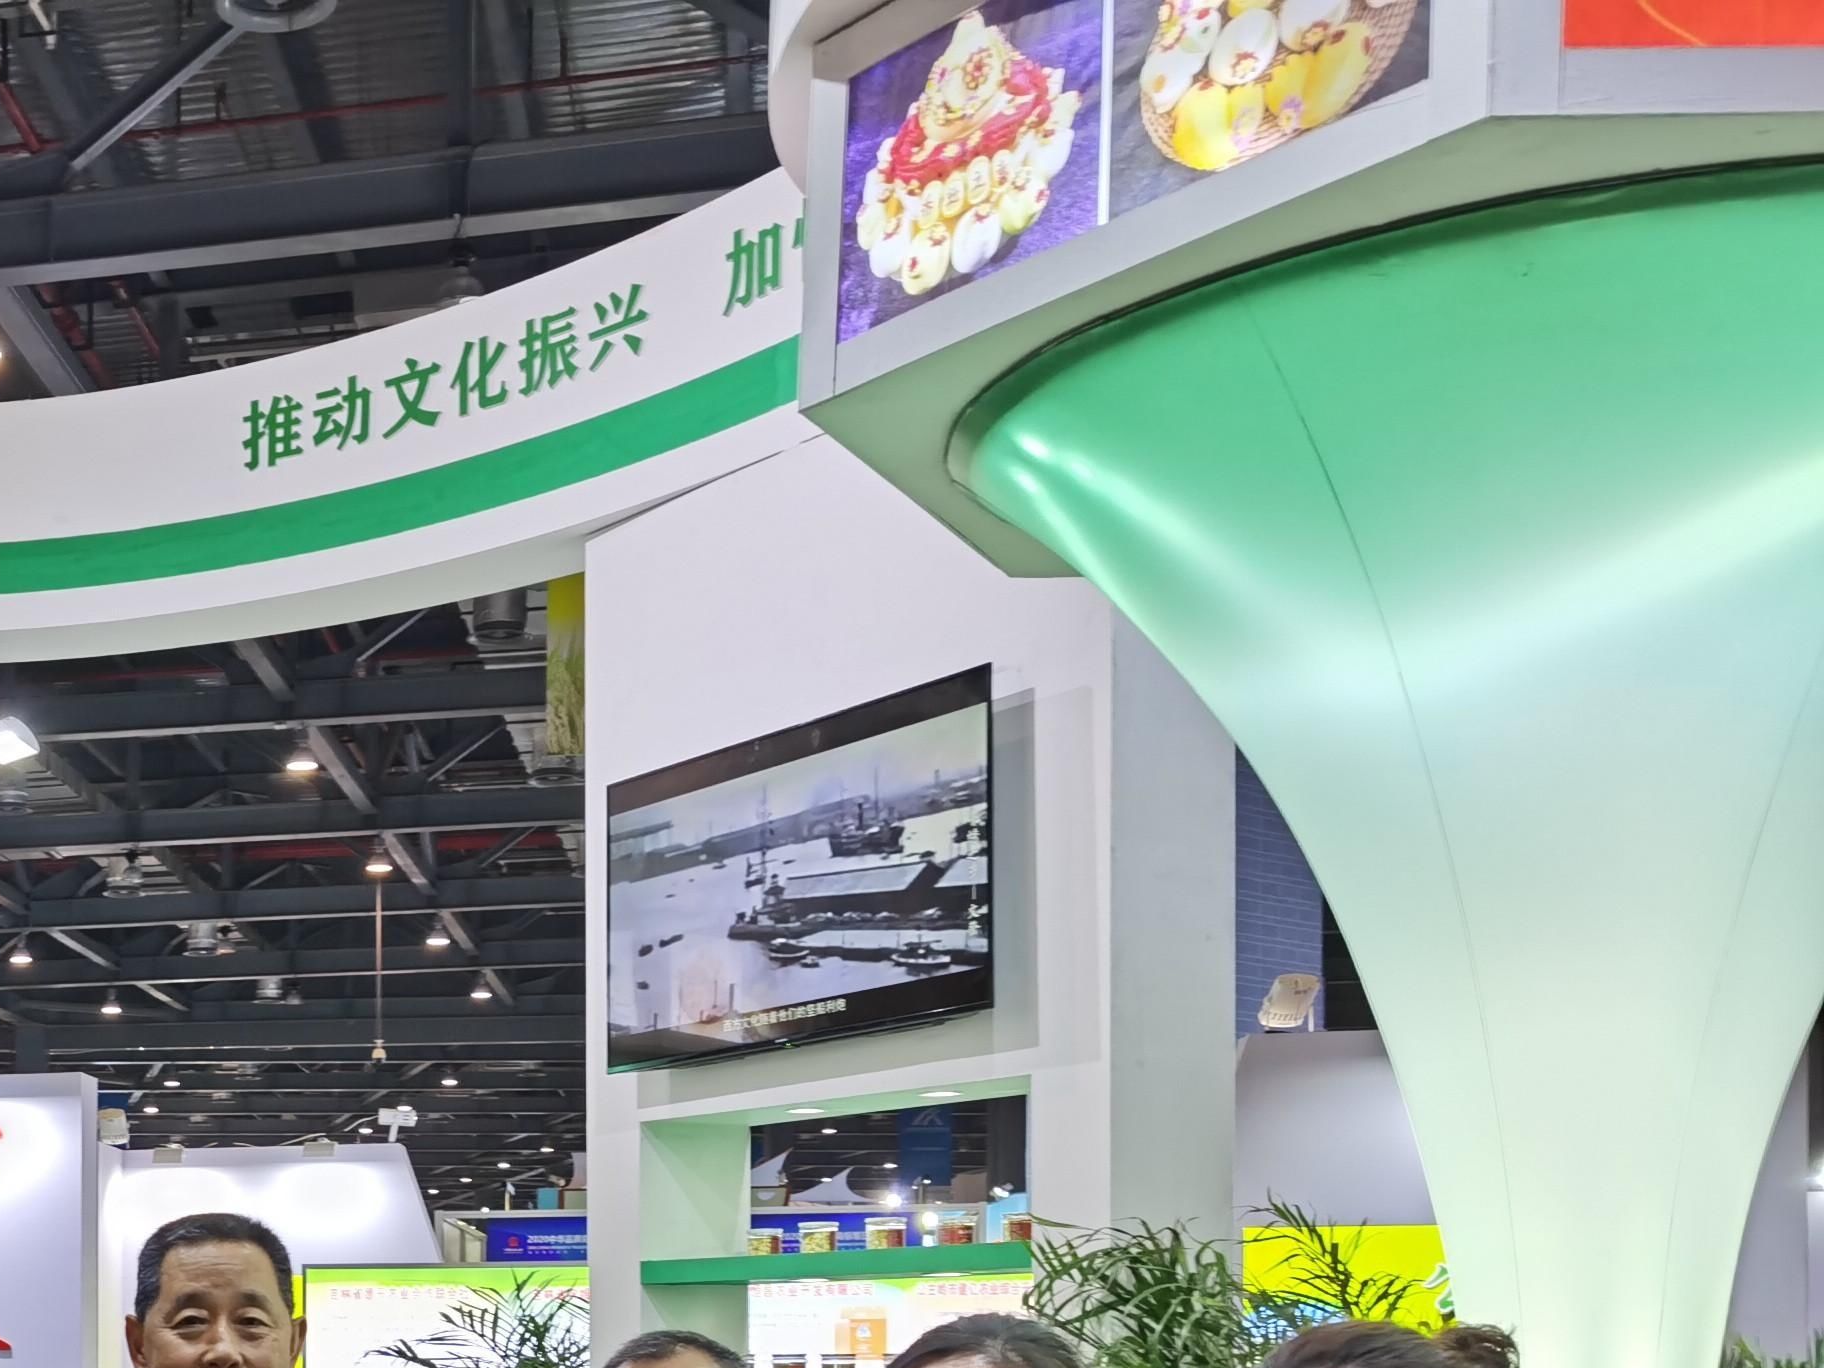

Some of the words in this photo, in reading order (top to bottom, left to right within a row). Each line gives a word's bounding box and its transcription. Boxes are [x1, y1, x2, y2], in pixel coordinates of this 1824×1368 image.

[241, 284, 651, 472] 推动文化振兴
